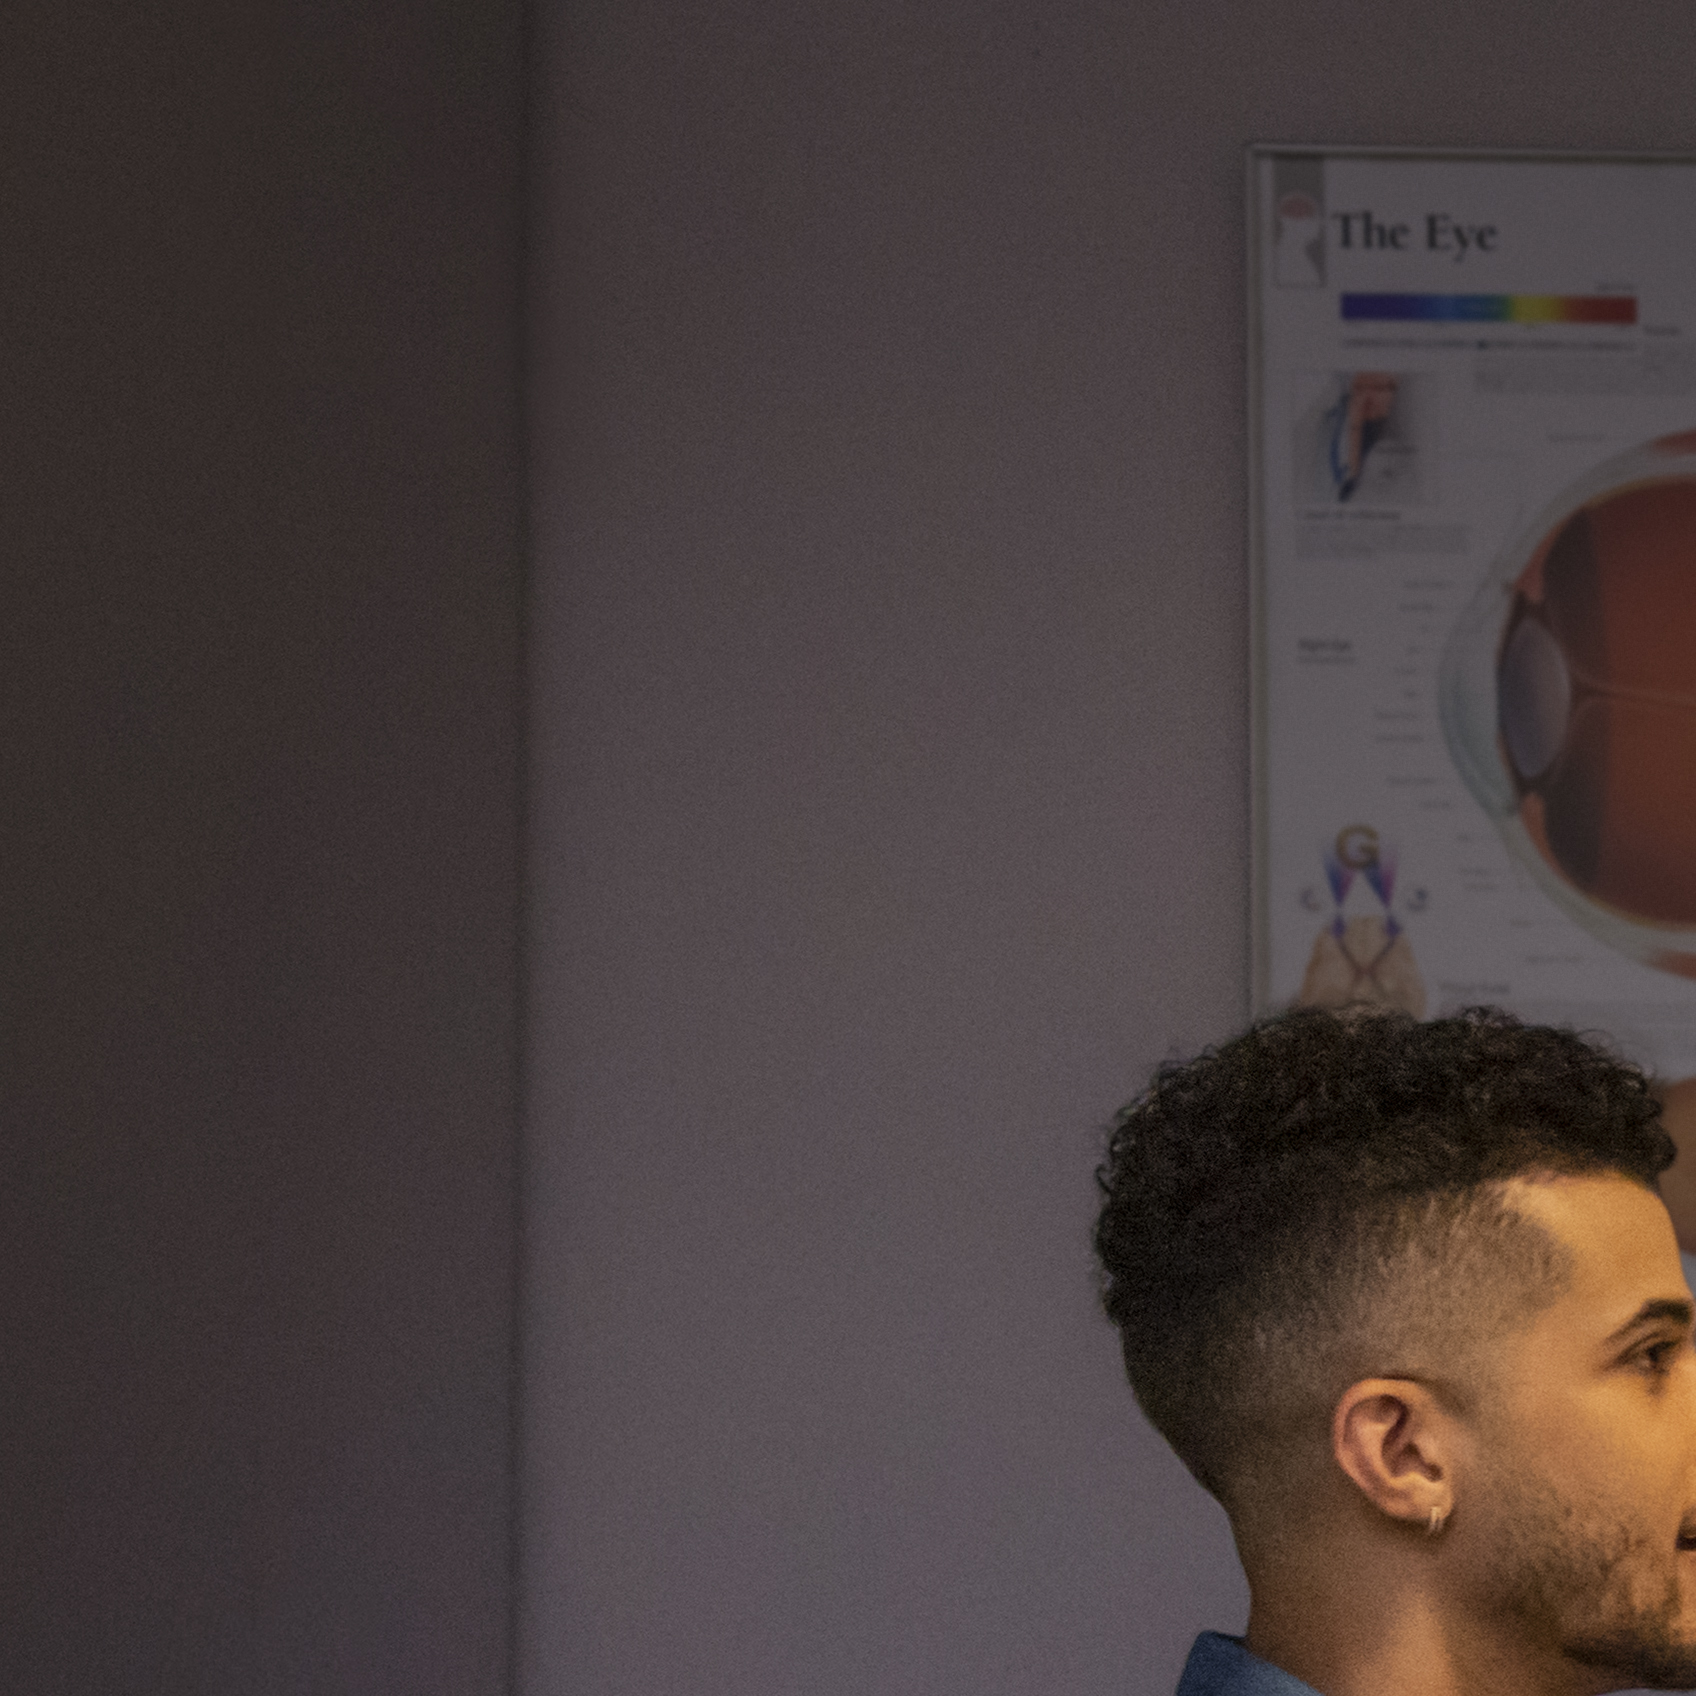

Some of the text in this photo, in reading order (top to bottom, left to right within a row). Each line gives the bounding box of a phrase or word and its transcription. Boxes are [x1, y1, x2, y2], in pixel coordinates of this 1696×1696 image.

[1331, 211, 1498, 263] The Eye
[1335, 824, 1380, 870] G
